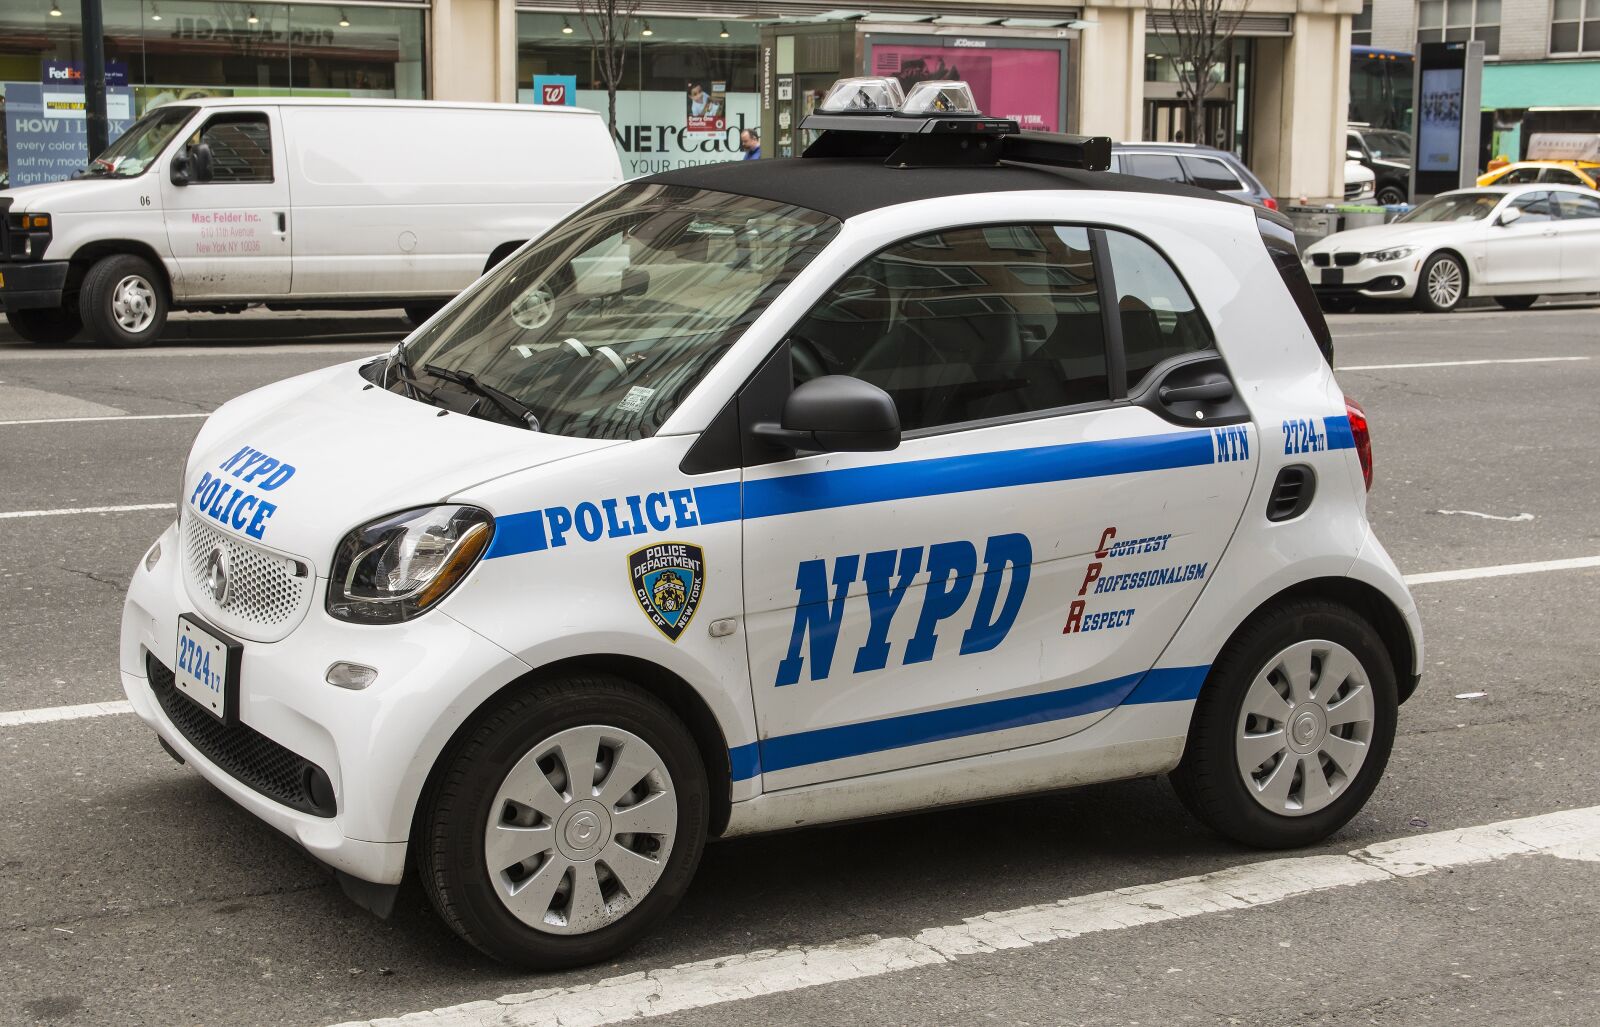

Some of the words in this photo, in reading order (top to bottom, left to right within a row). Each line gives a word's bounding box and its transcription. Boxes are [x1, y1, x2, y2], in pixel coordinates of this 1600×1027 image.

[49, 67, 81, 79] FedEx
[15, 119, 59, 132] HOW
[77, 119, 125, 133] LK
[16, 141, 46, 151] every
[48, 140, 75, 150] color
[17, 156, 36, 166] suit
[38, 157, 54, 168] my
[630, 159, 671, 173] YOUR
[17, 172, 41, 183] right
[140, 196, 150, 206] 06
[192, 213, 210, 223] Mac
[213, 212, 242, 222] Felder
[244, 212, 261, 222] Inc.
[196, 243, 210, 253] New
[212, 242, 227, 252] York
[229, 242, 238, 252] NY
[1214, 425, 1249, 463] MTN
[219, 445, 296, 491] NYPD
[190, 471, 278, 540] POLICE
[544, 489, 699, 548] POLICE
[646, 545, 687, 560] POLICE
[634, 556, 701, 579] DEPARTMENT
[637, 588, 655, 613] CITY
[652, 613, 666, 626] OF
[677, 605, 694, 629] NEW
[689, 577, 702, 603] YORK
[775, 532, 1032, 687] NYPD
